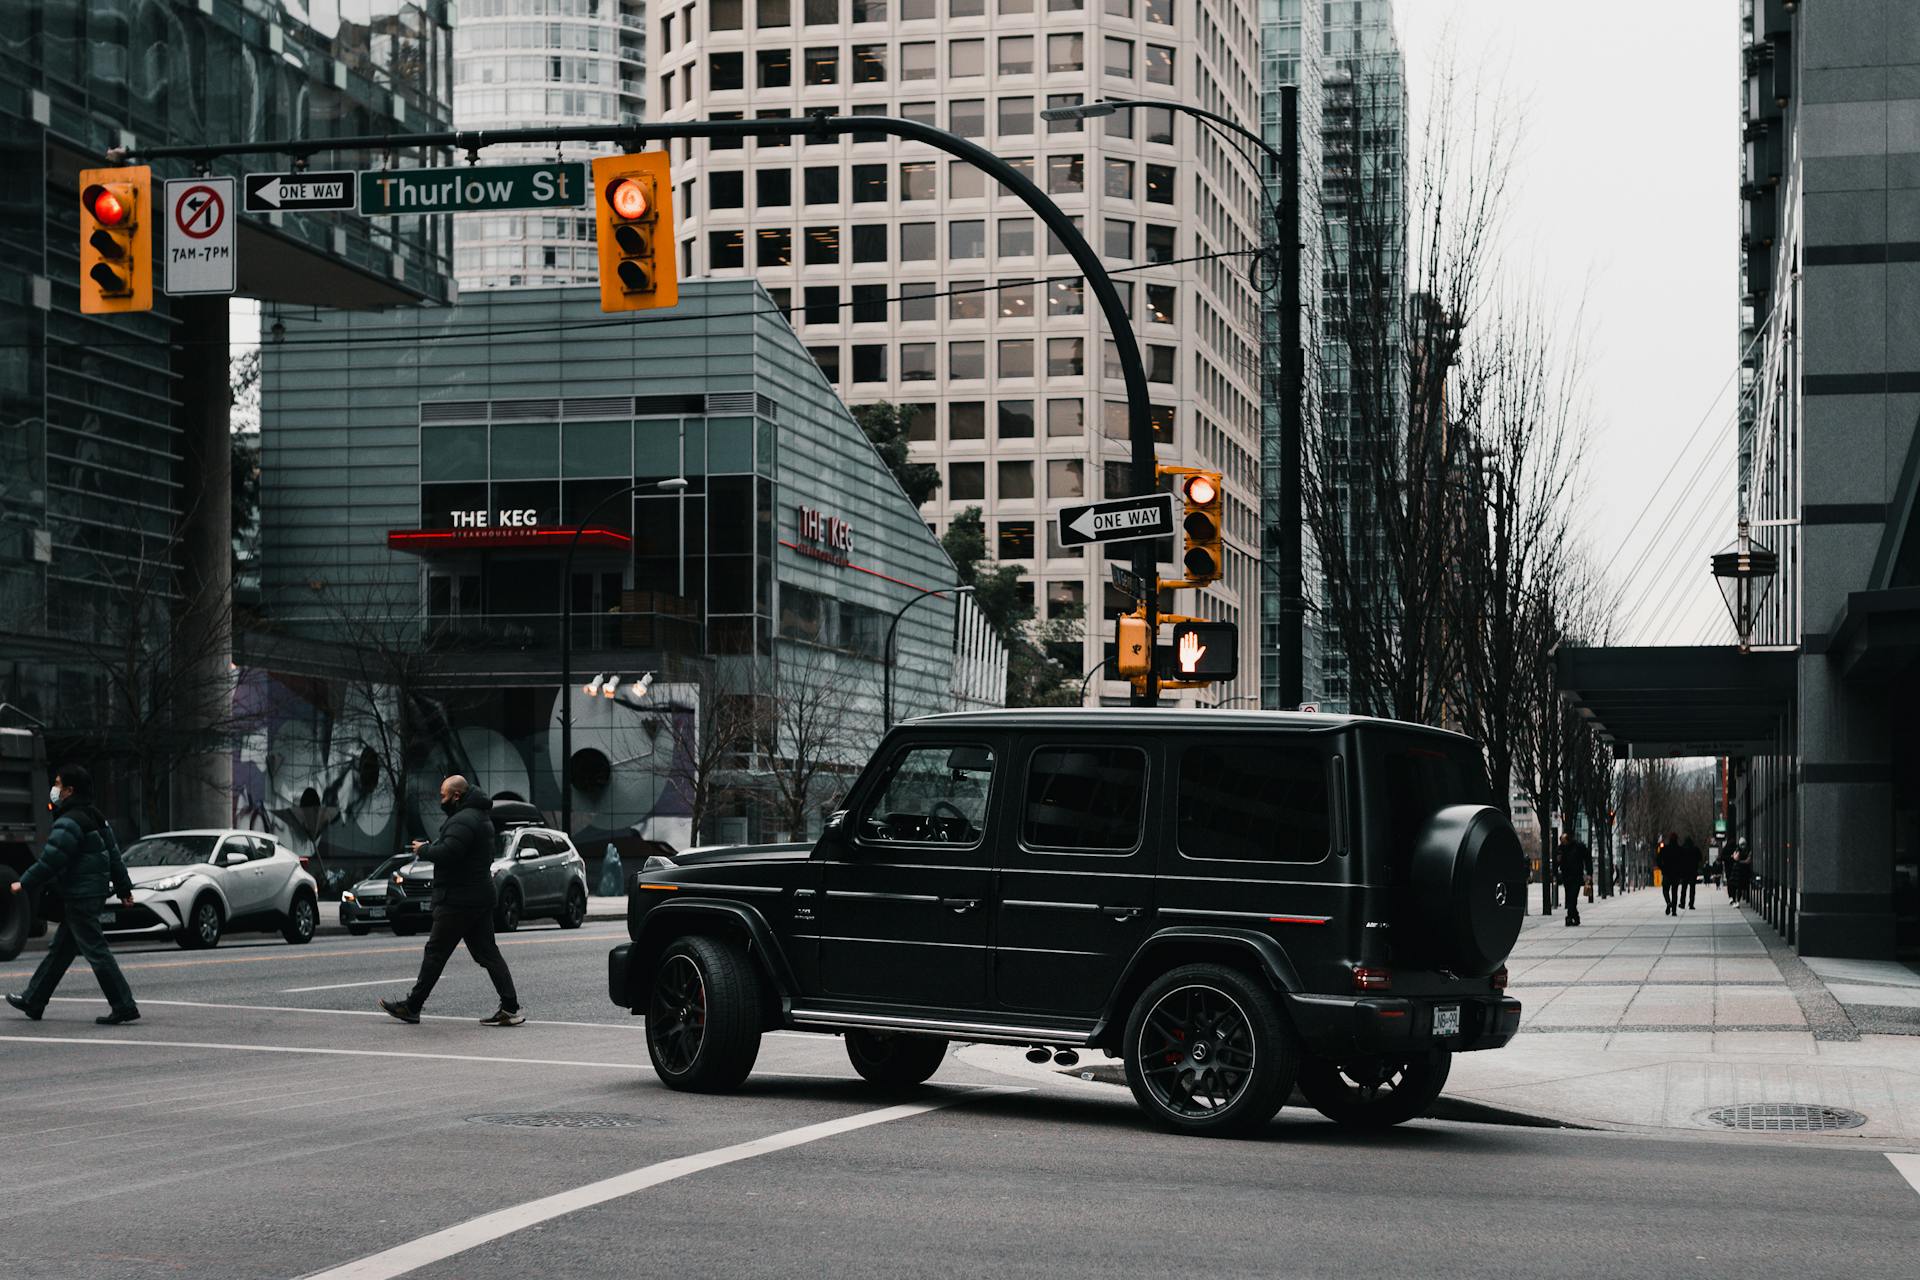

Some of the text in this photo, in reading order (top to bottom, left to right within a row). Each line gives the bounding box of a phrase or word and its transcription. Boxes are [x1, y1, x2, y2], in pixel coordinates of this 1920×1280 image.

[279, 183, 341, 200] ONE WAY
[376, 170, 569, 207] Thurlow St
[172, 246, 229, 263] 7AM-7PM
[450, 508, 538, 528] THE KEG
[1093, 509, 1158, 529] ONE WAY
[801, 505, 854, 552] THE KEG
